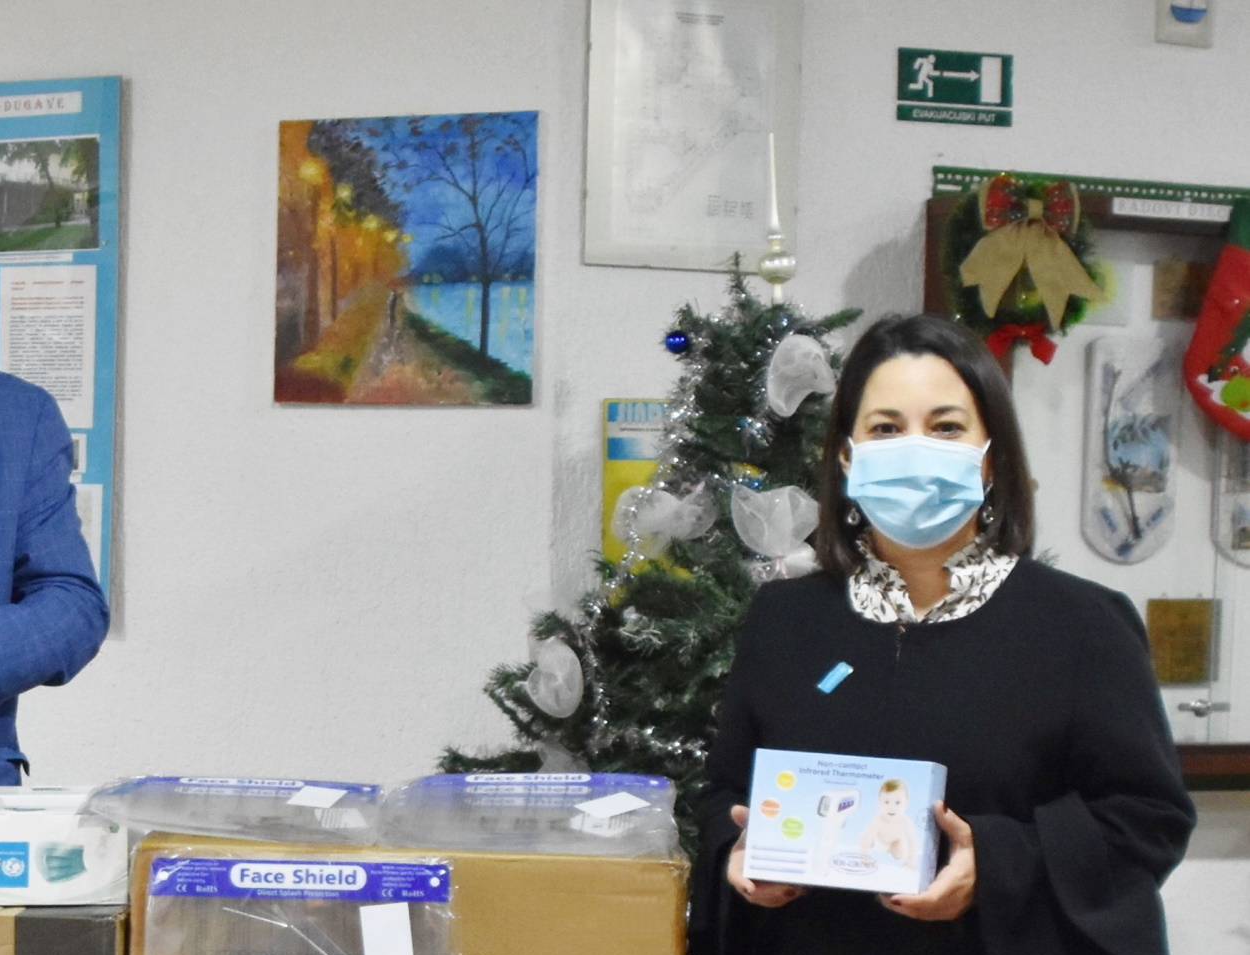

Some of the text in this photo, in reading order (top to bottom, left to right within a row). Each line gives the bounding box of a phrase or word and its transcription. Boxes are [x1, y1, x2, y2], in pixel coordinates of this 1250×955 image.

[799, 767, 884, 780] Infrared Thermometer
[240, 868, 285, 884] Face
[292, 869, 357, 885] Shield
